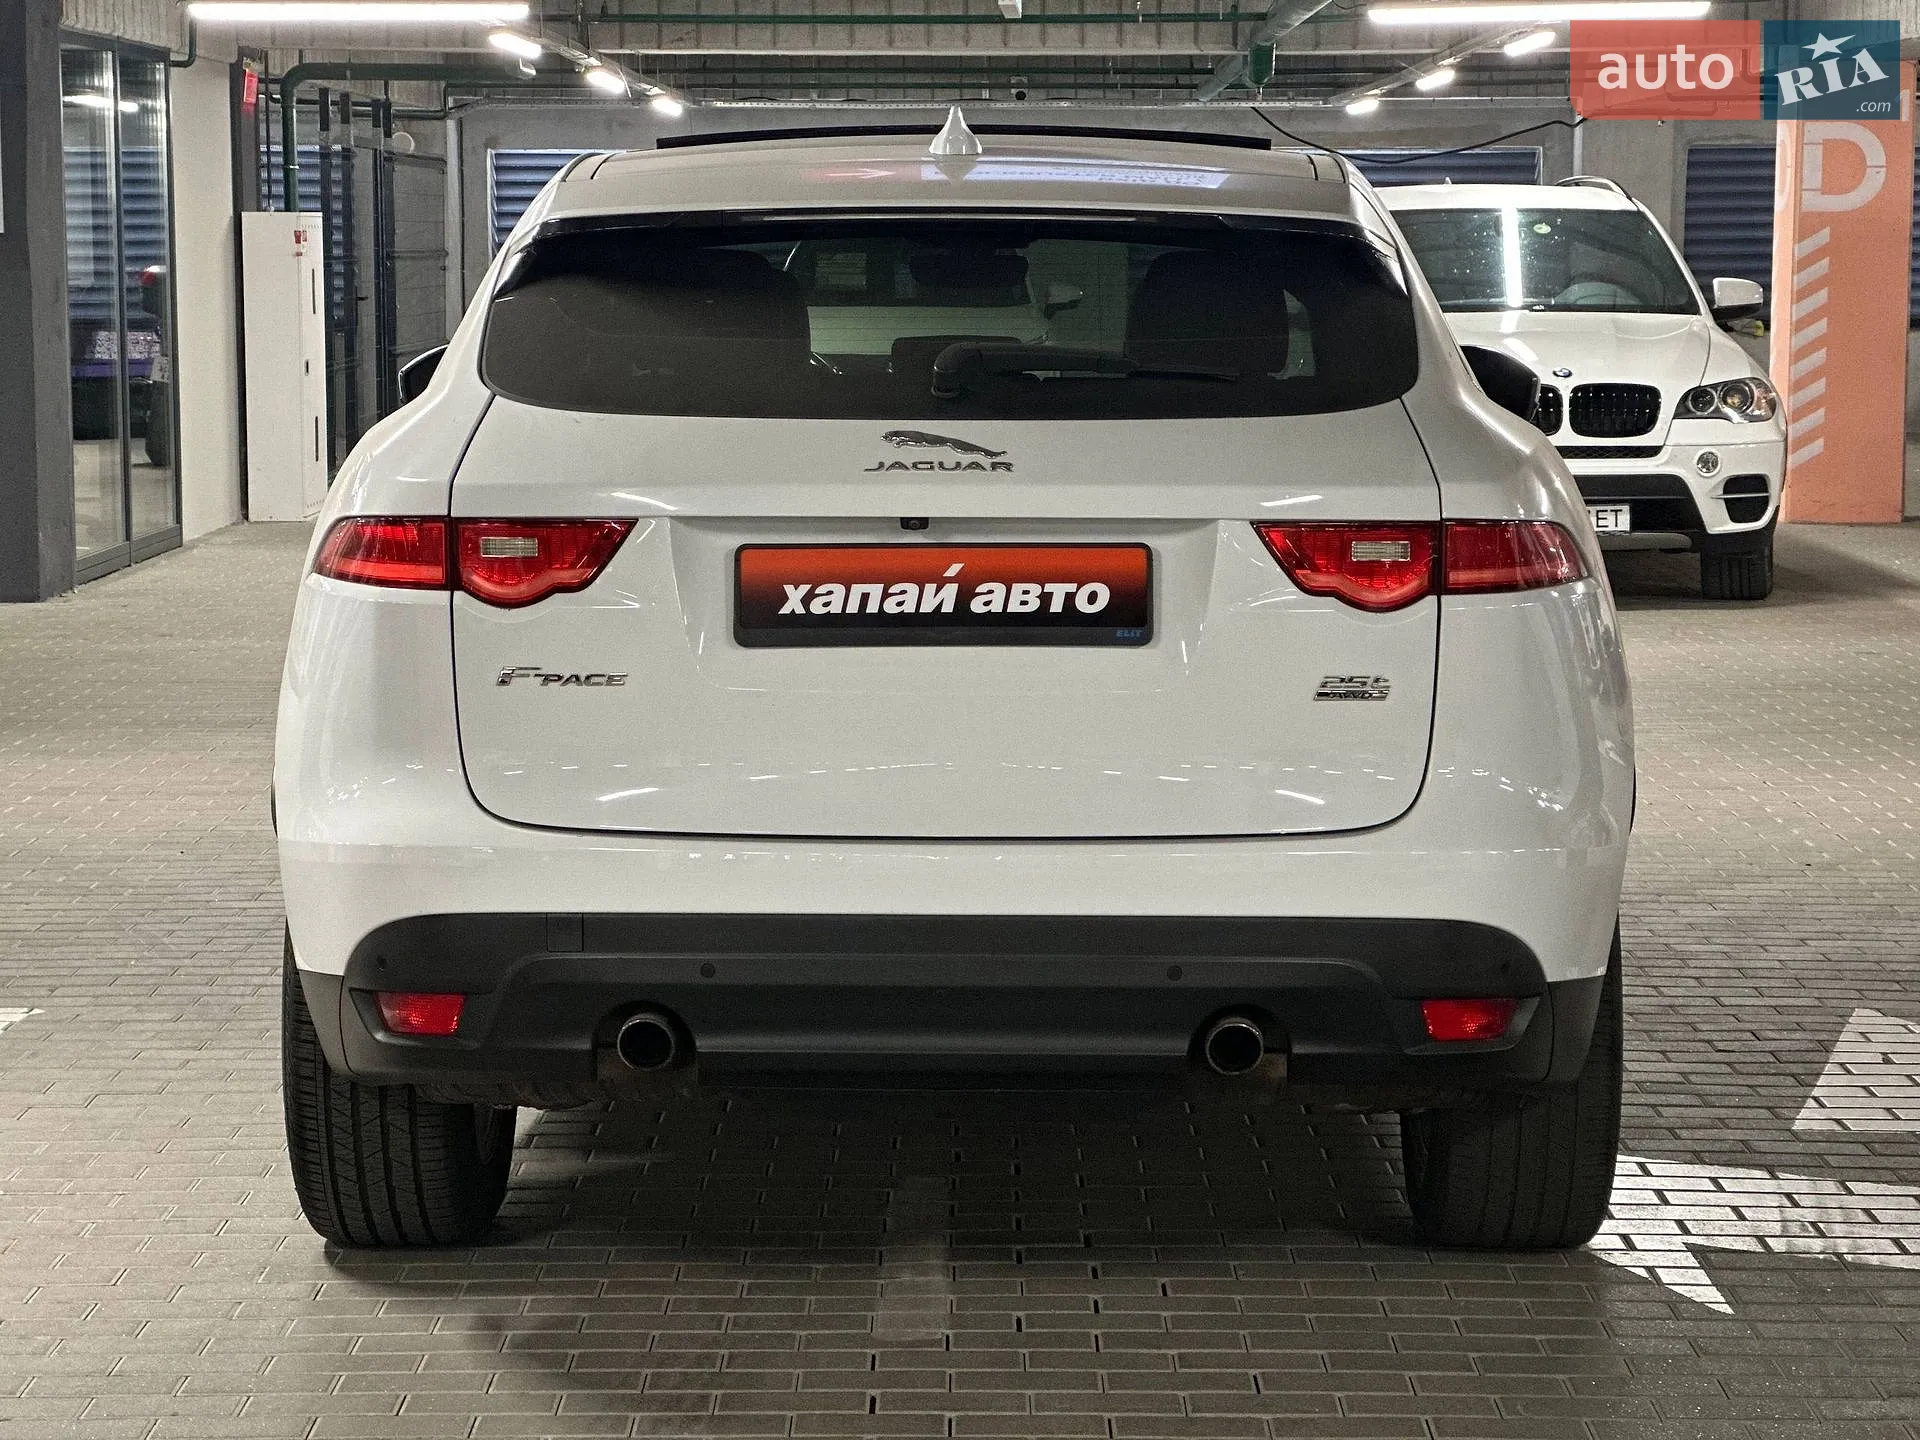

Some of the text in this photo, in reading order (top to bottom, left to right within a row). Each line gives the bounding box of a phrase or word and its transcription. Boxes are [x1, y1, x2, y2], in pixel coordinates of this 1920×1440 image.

[1801, 122, 1887, 212] D
[864, 461, 1015, 473] JAGUAR
[1596, 509, 1623, 528] ET
[970, 582, 1111, 614] авто
